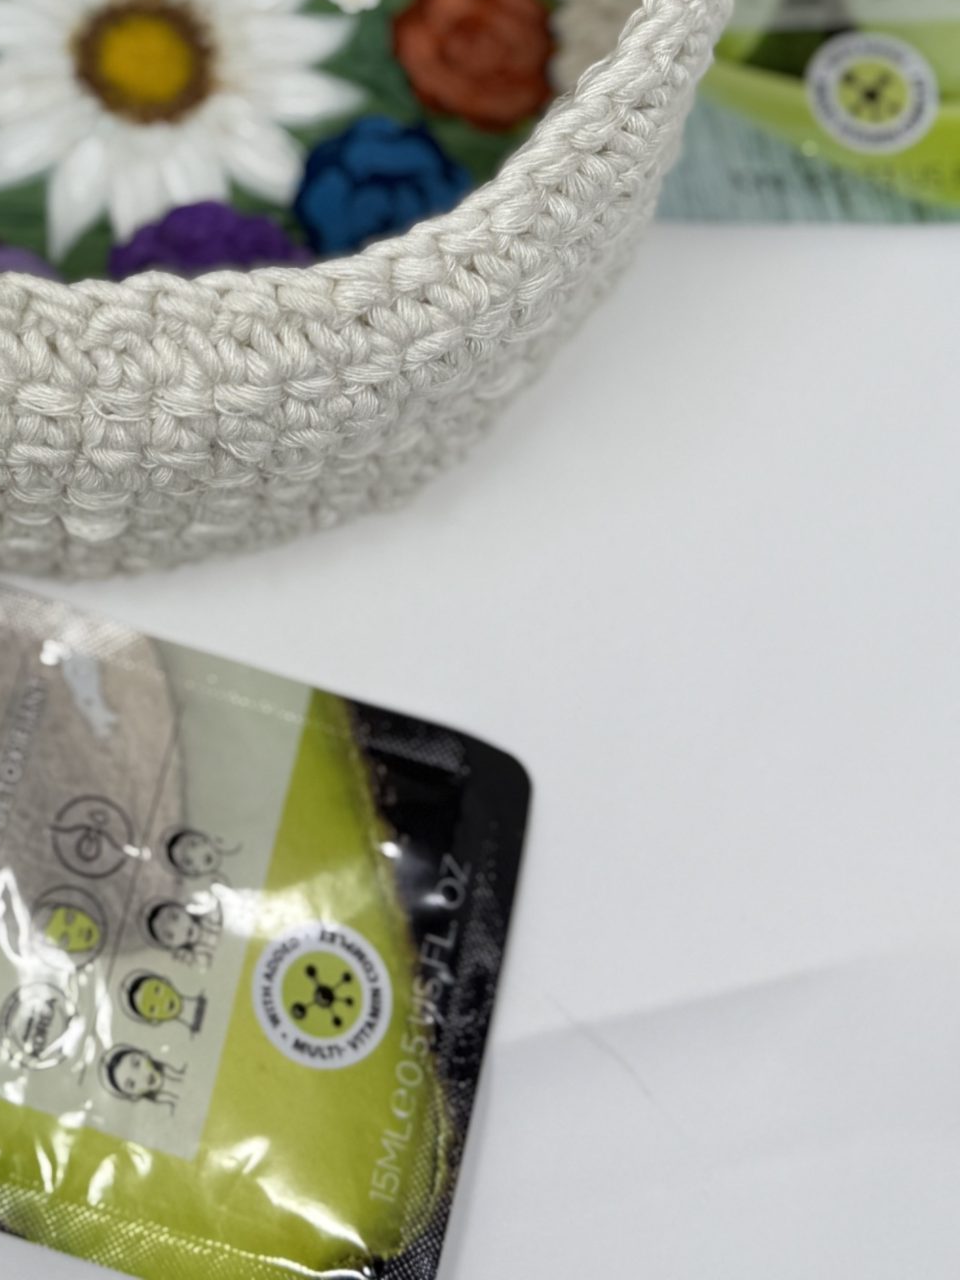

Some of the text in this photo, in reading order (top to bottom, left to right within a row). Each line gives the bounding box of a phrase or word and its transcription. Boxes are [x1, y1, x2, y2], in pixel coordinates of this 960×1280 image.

[436, 853, 472, 910] OZ
[262, 937, 300, 1028] WITH ADDED
[347, 987, 381, 1051] VITAMIN
